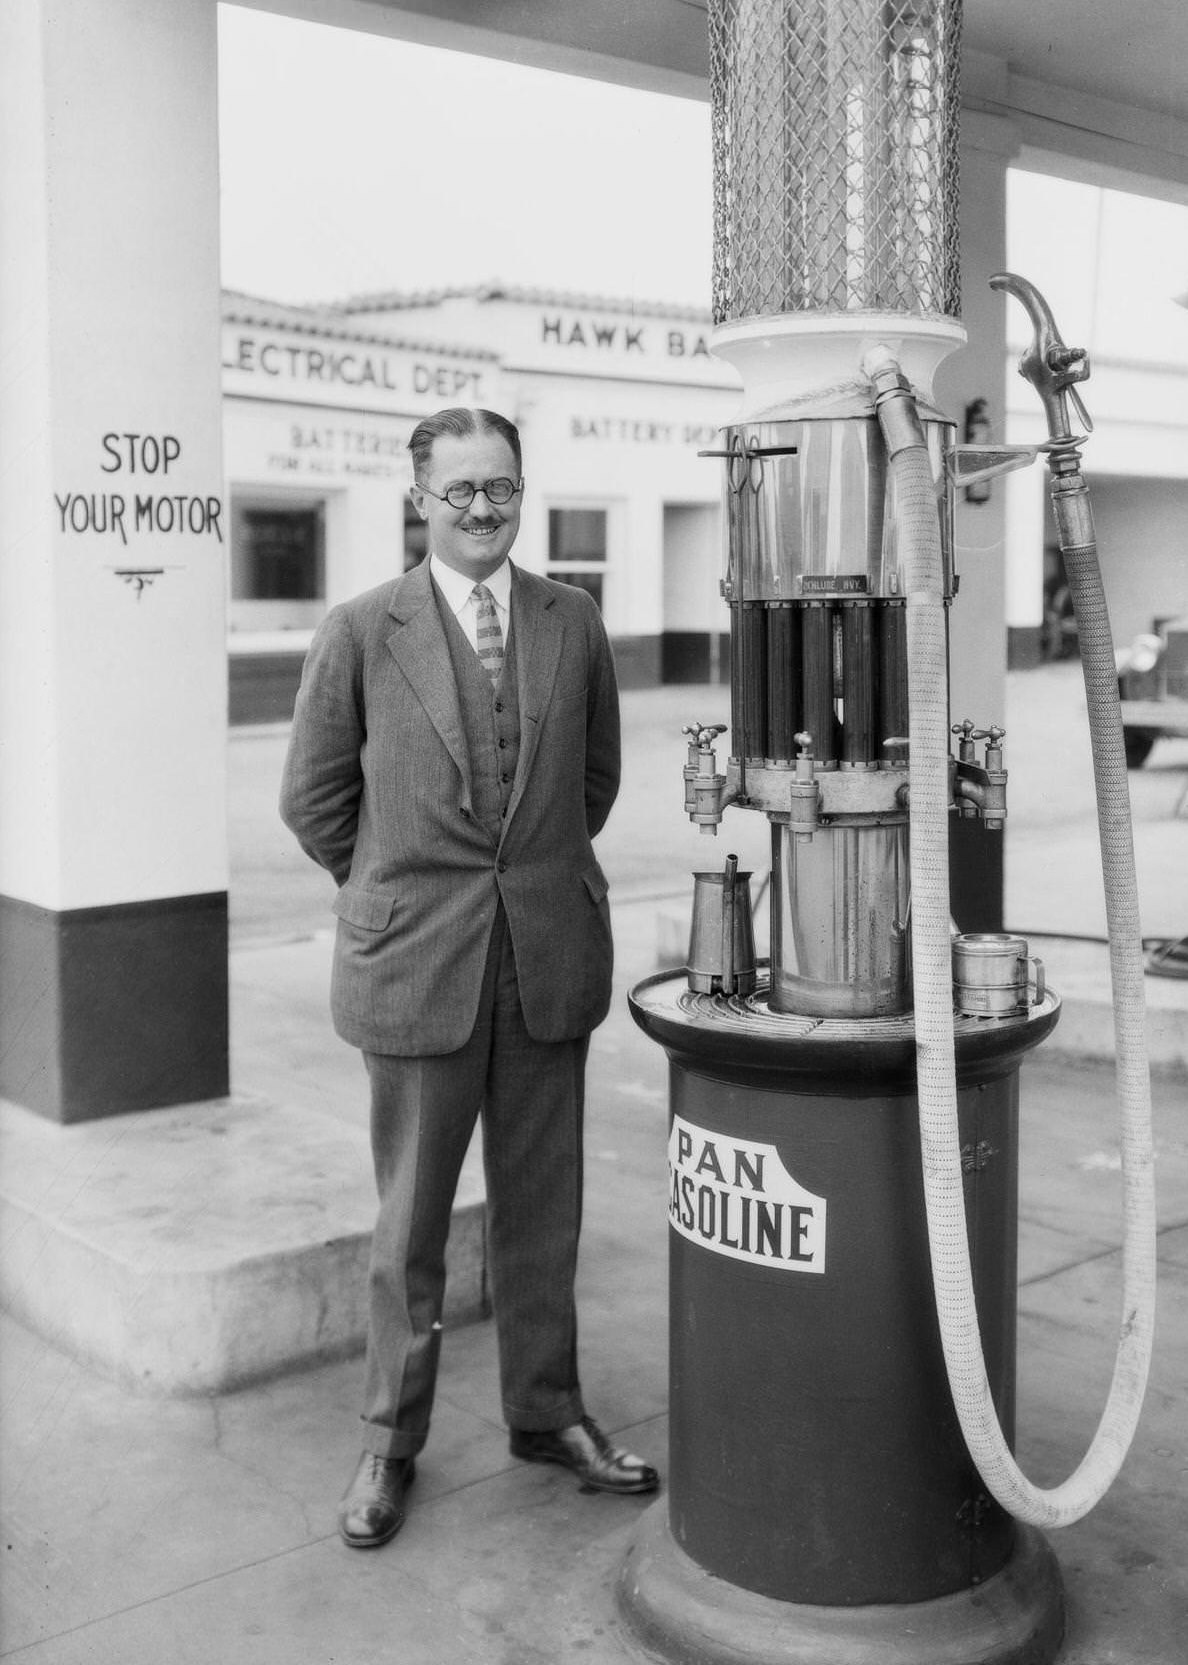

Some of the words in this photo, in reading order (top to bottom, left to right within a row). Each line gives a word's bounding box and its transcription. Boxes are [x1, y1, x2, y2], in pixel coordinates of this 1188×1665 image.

[542, 316, 645, 353] HAWK
[100, 432, 181, 475] STOP
[54, 492, 128, 546] YOUR
[135, 493, 223, 543] MOTOR
[677, 1127, 767, 1194] PAN
[669, 1160, 815, 1263] ASOLINE
